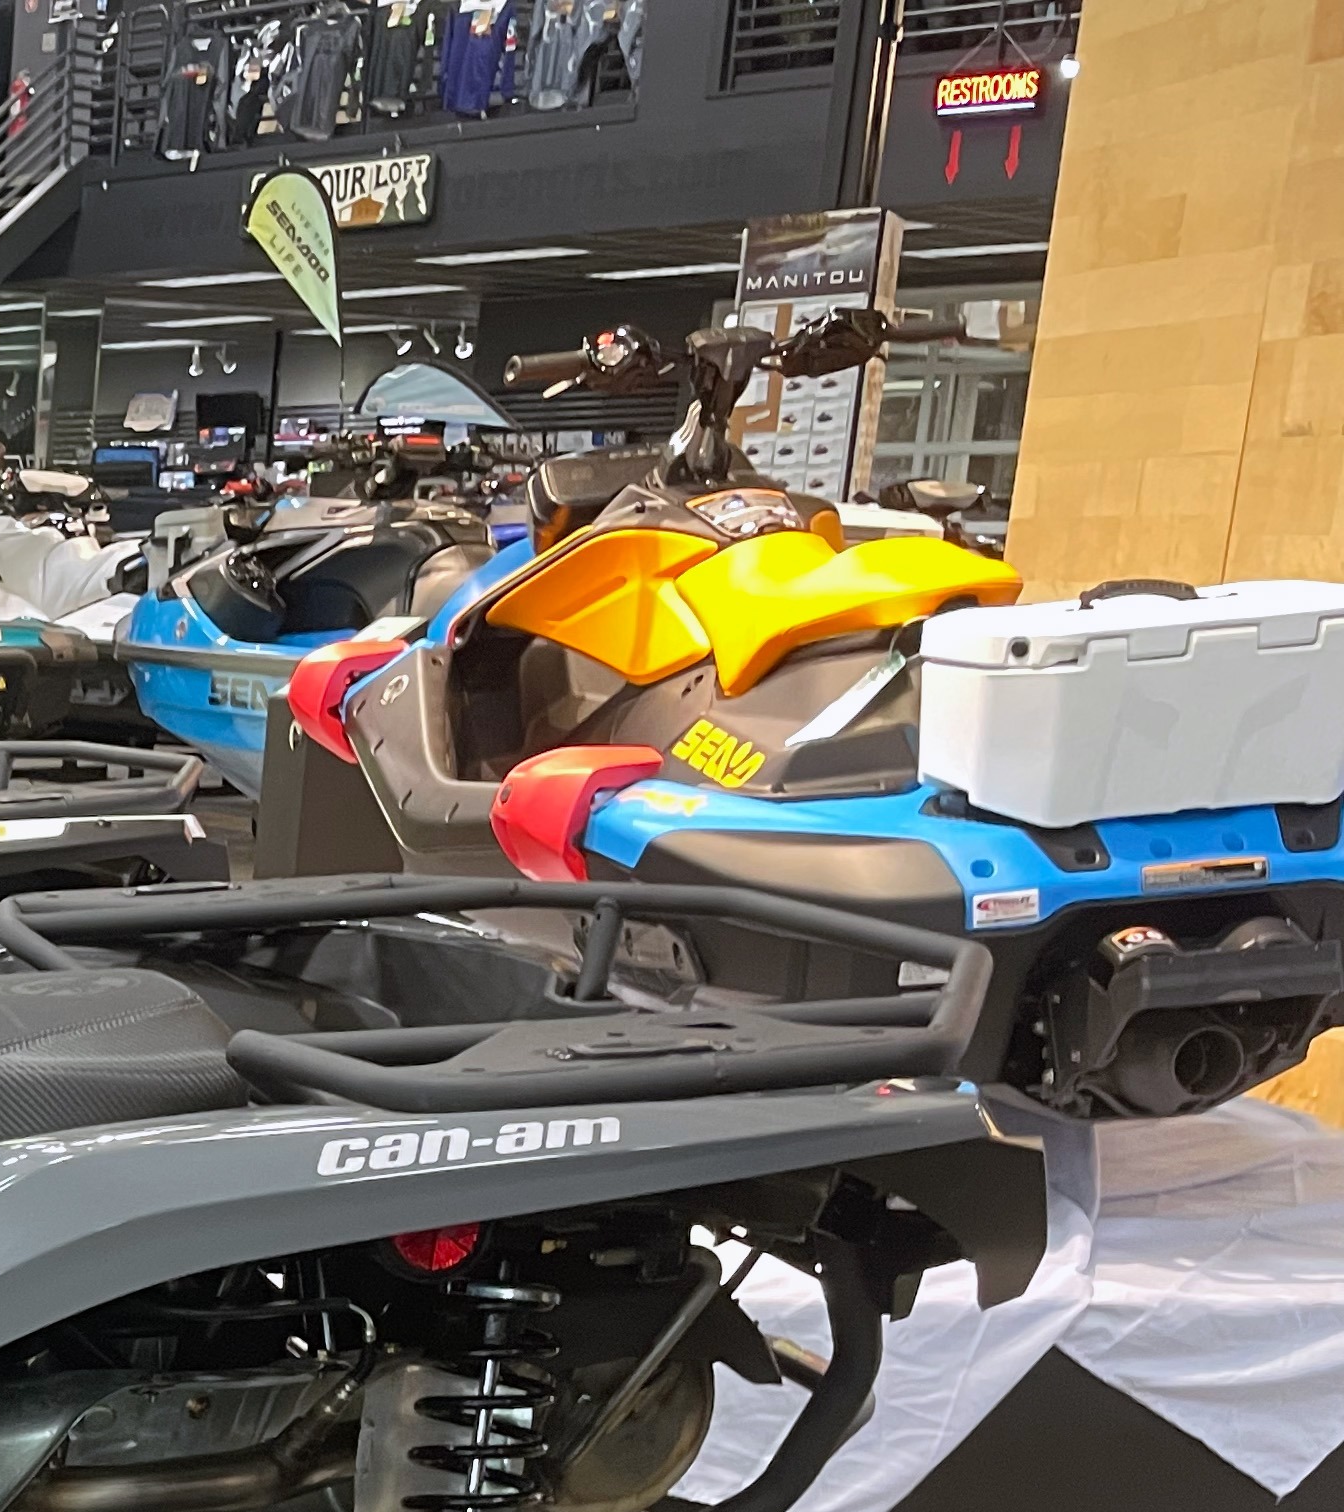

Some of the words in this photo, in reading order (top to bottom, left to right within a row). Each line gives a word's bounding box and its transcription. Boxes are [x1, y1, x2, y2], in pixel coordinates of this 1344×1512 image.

[937, 71, 1040, 108] RESTROOMS
[374, 157, 426, 191] LOFT
[269, 234, 303, 278] LIFE
[746, 268, 865, 290] MANITOU
